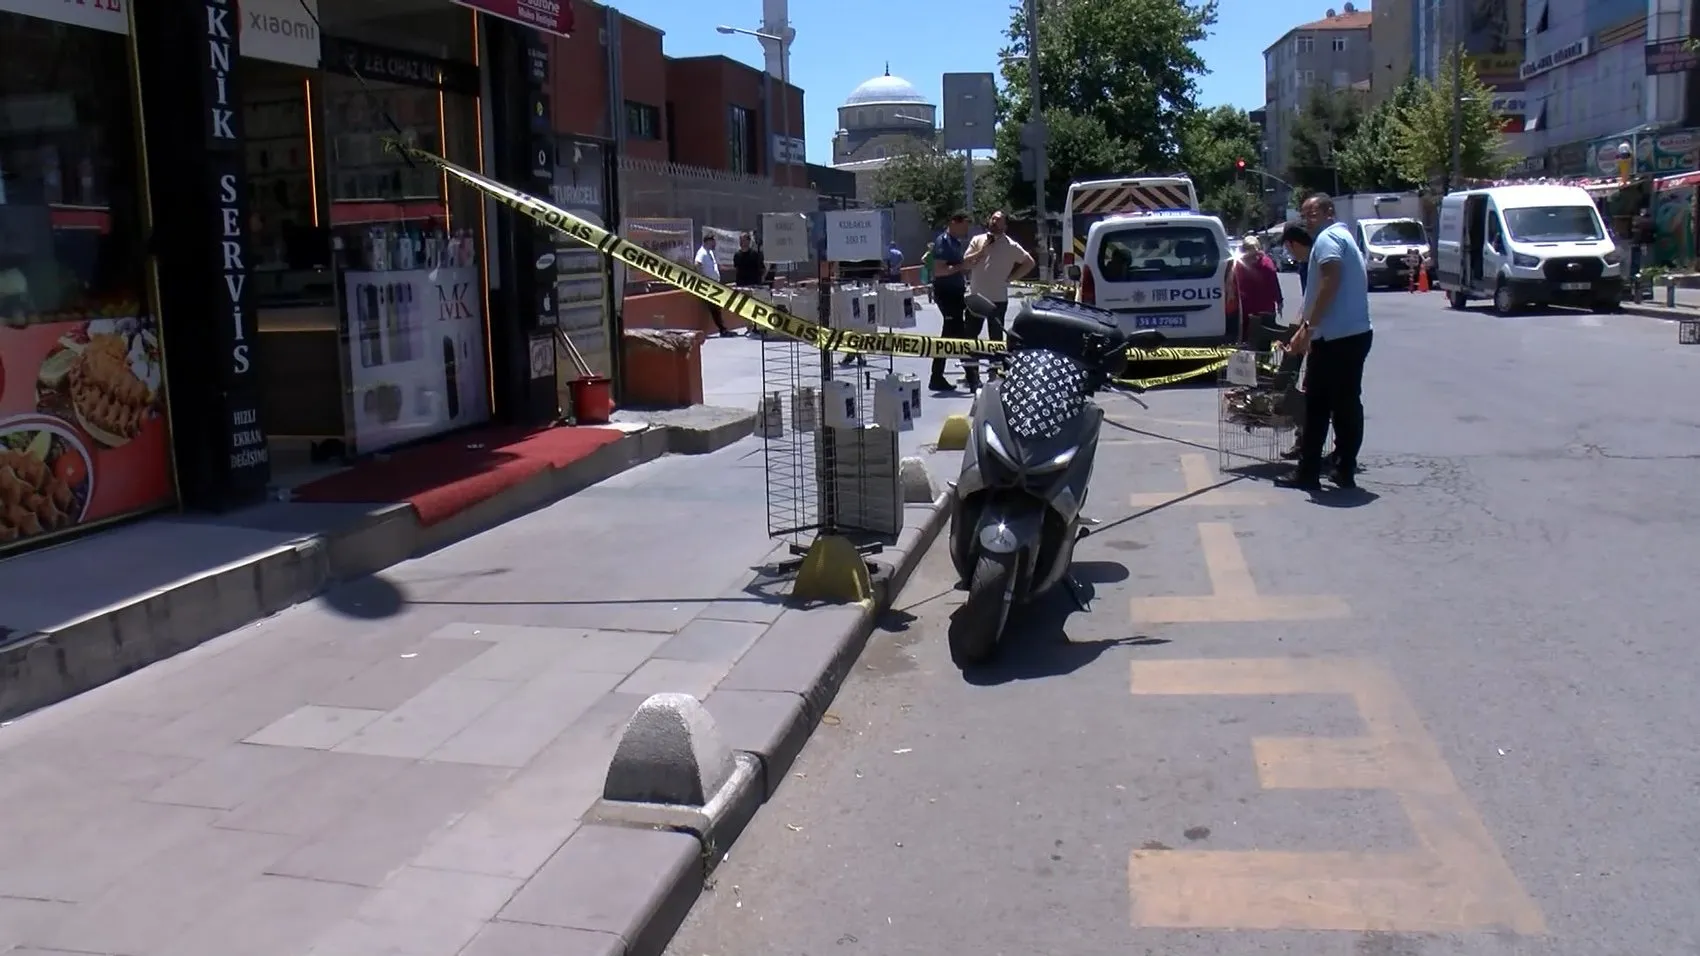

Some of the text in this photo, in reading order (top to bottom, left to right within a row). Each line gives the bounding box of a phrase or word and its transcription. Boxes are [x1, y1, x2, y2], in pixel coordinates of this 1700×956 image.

[250, 11, 316, 40] xiaomi
[206, 0, 250, 374] KNİK SERVİS
[622, 248, 725, 302] GİRİLMEZ
[847, 334, 919, 354] GİRİLMEZ
